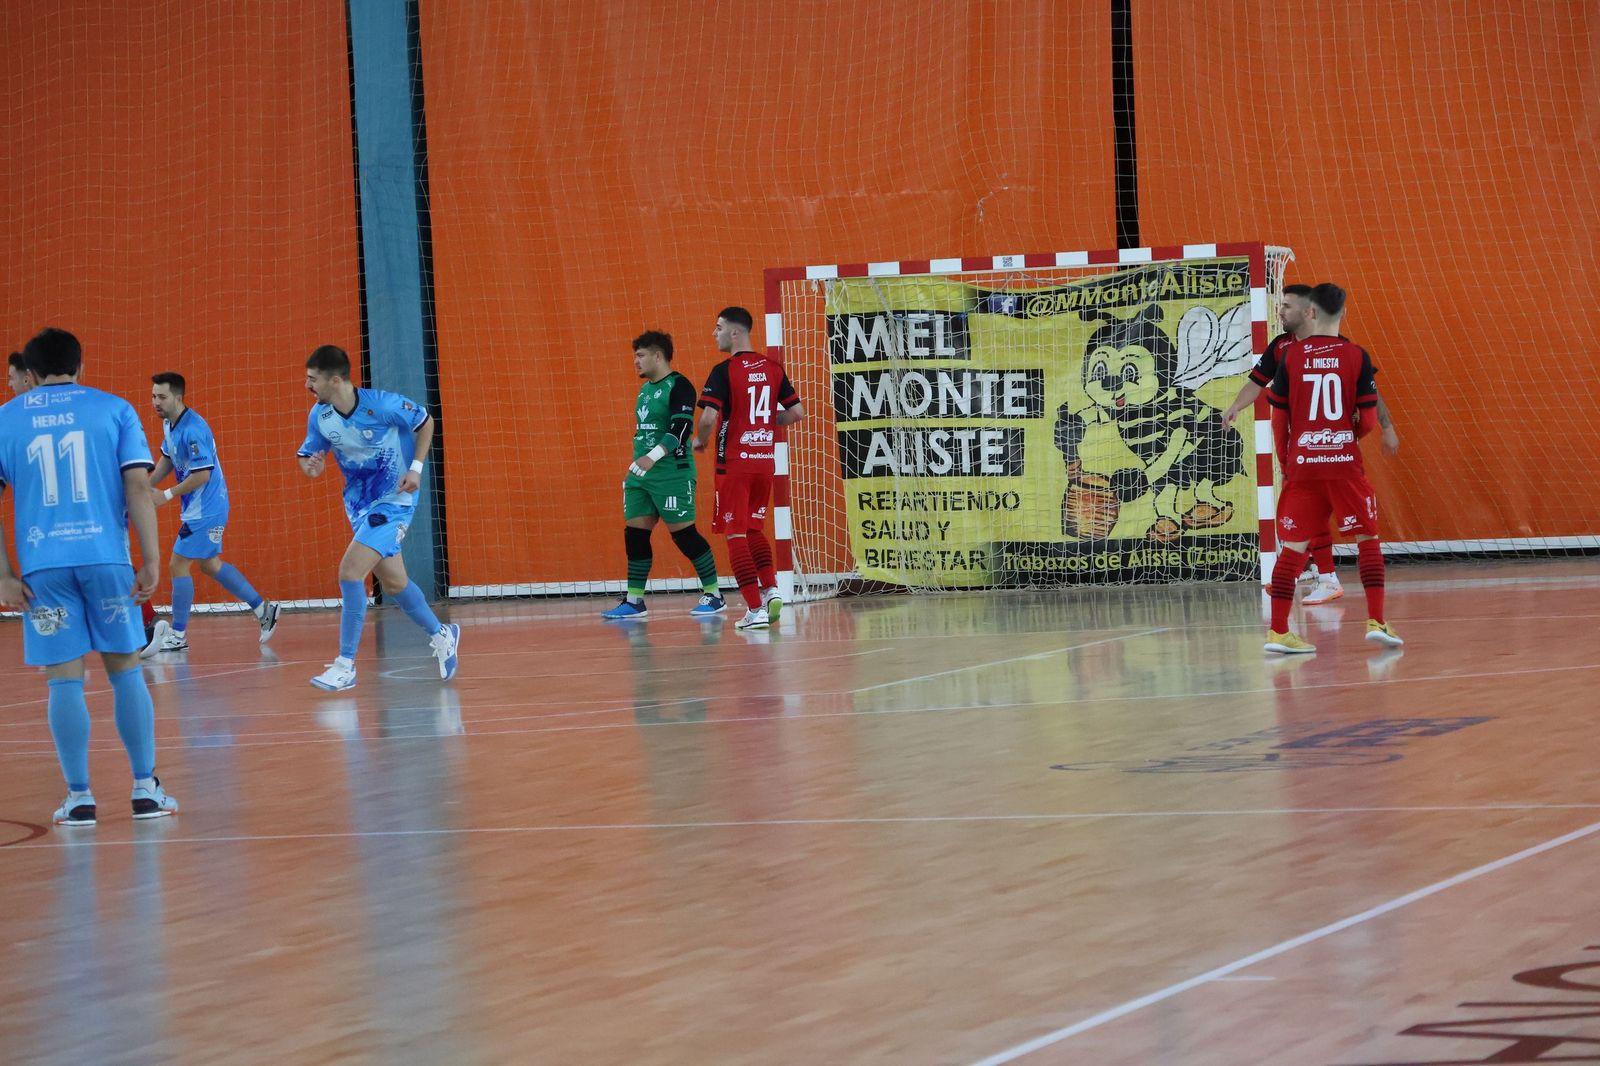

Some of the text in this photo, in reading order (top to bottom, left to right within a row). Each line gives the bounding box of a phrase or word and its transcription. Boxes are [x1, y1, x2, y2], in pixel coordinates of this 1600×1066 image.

[846, 313, 956, 360] MIEL
[747, 385, 771, 425] 14
[851, 371, 1028, 418] MONTE
[1302, 372, 1343, 421] 70
[32, 412, 75, 429] HERAS
[26, 430, 89, 507] 11
[862, 430, 1004, 475] ALISTE
[861, 519, 951, 541] SALUD Y
[864, 548, 987, 571] BIENESTAR
[1095, 551, 1121, 571] de
[1128, 548, 1180, 568] Aliste
